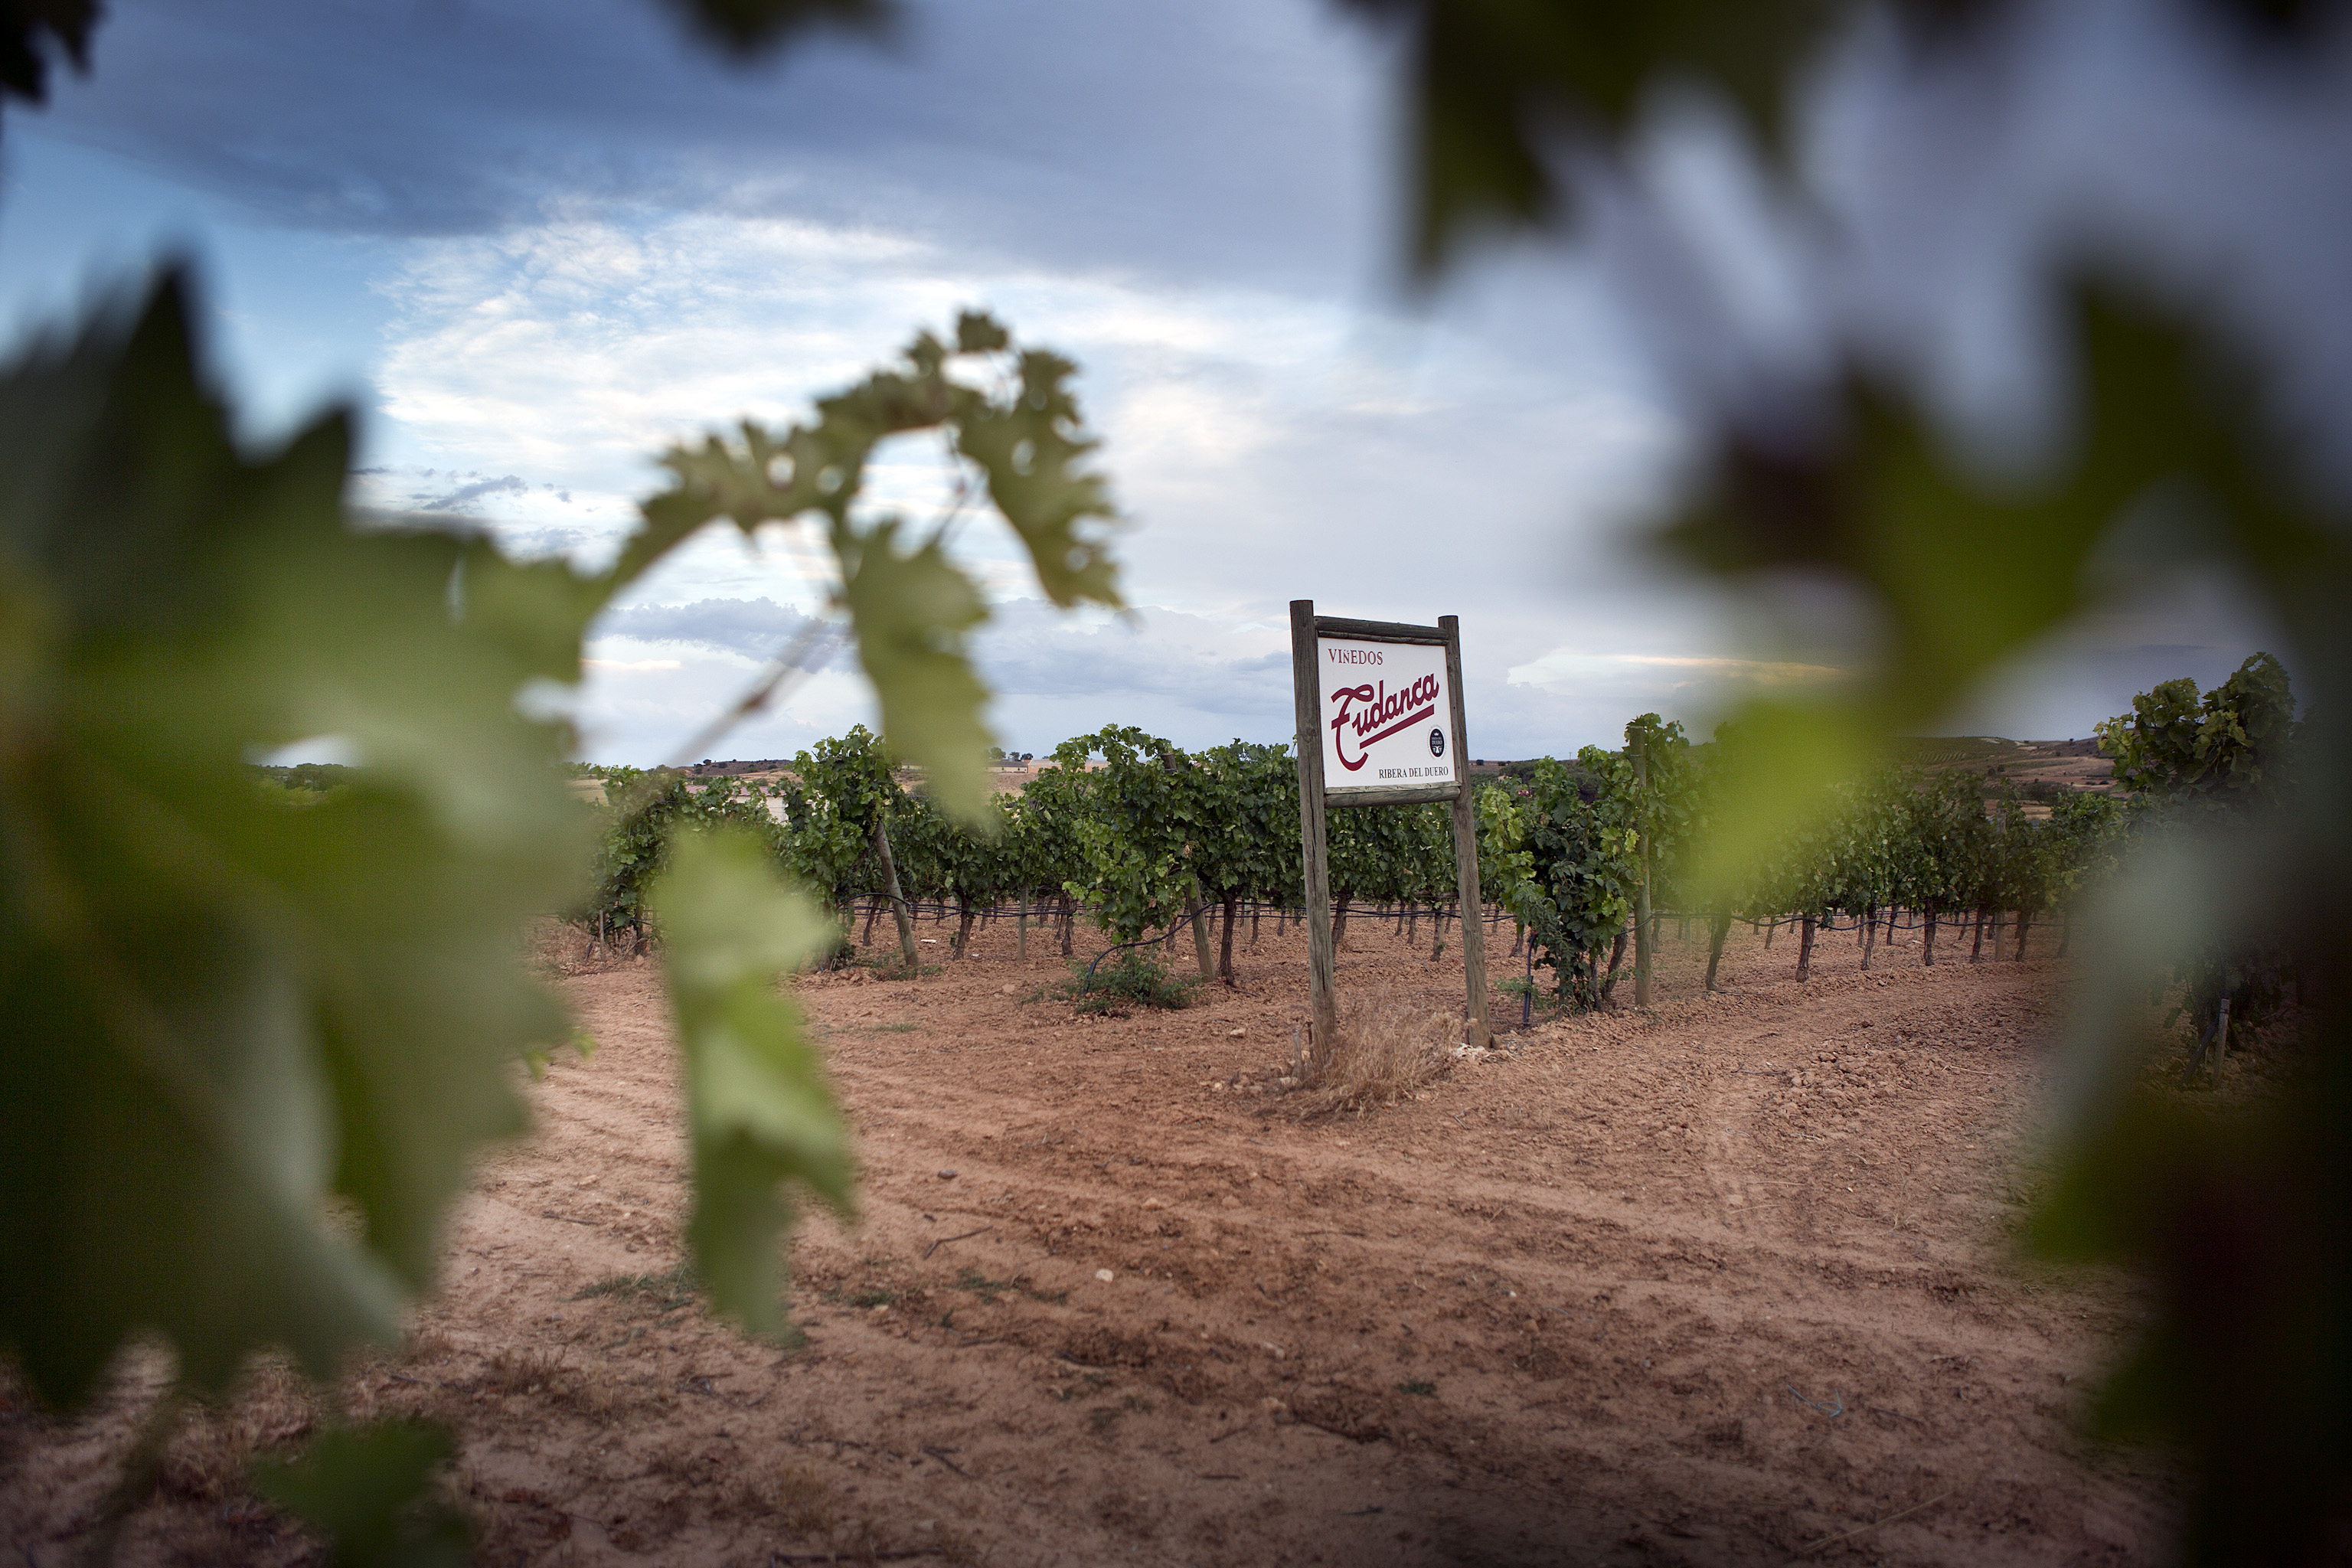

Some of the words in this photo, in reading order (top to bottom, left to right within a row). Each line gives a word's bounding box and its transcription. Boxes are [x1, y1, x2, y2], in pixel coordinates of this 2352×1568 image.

[1331, 673, 1439, 771] Tudanca
[1379, 768, 1407, 779] RIBERA
[1409, 767, 1423, 778] DEL
[1425, 766, 1449, 777] DUERO
